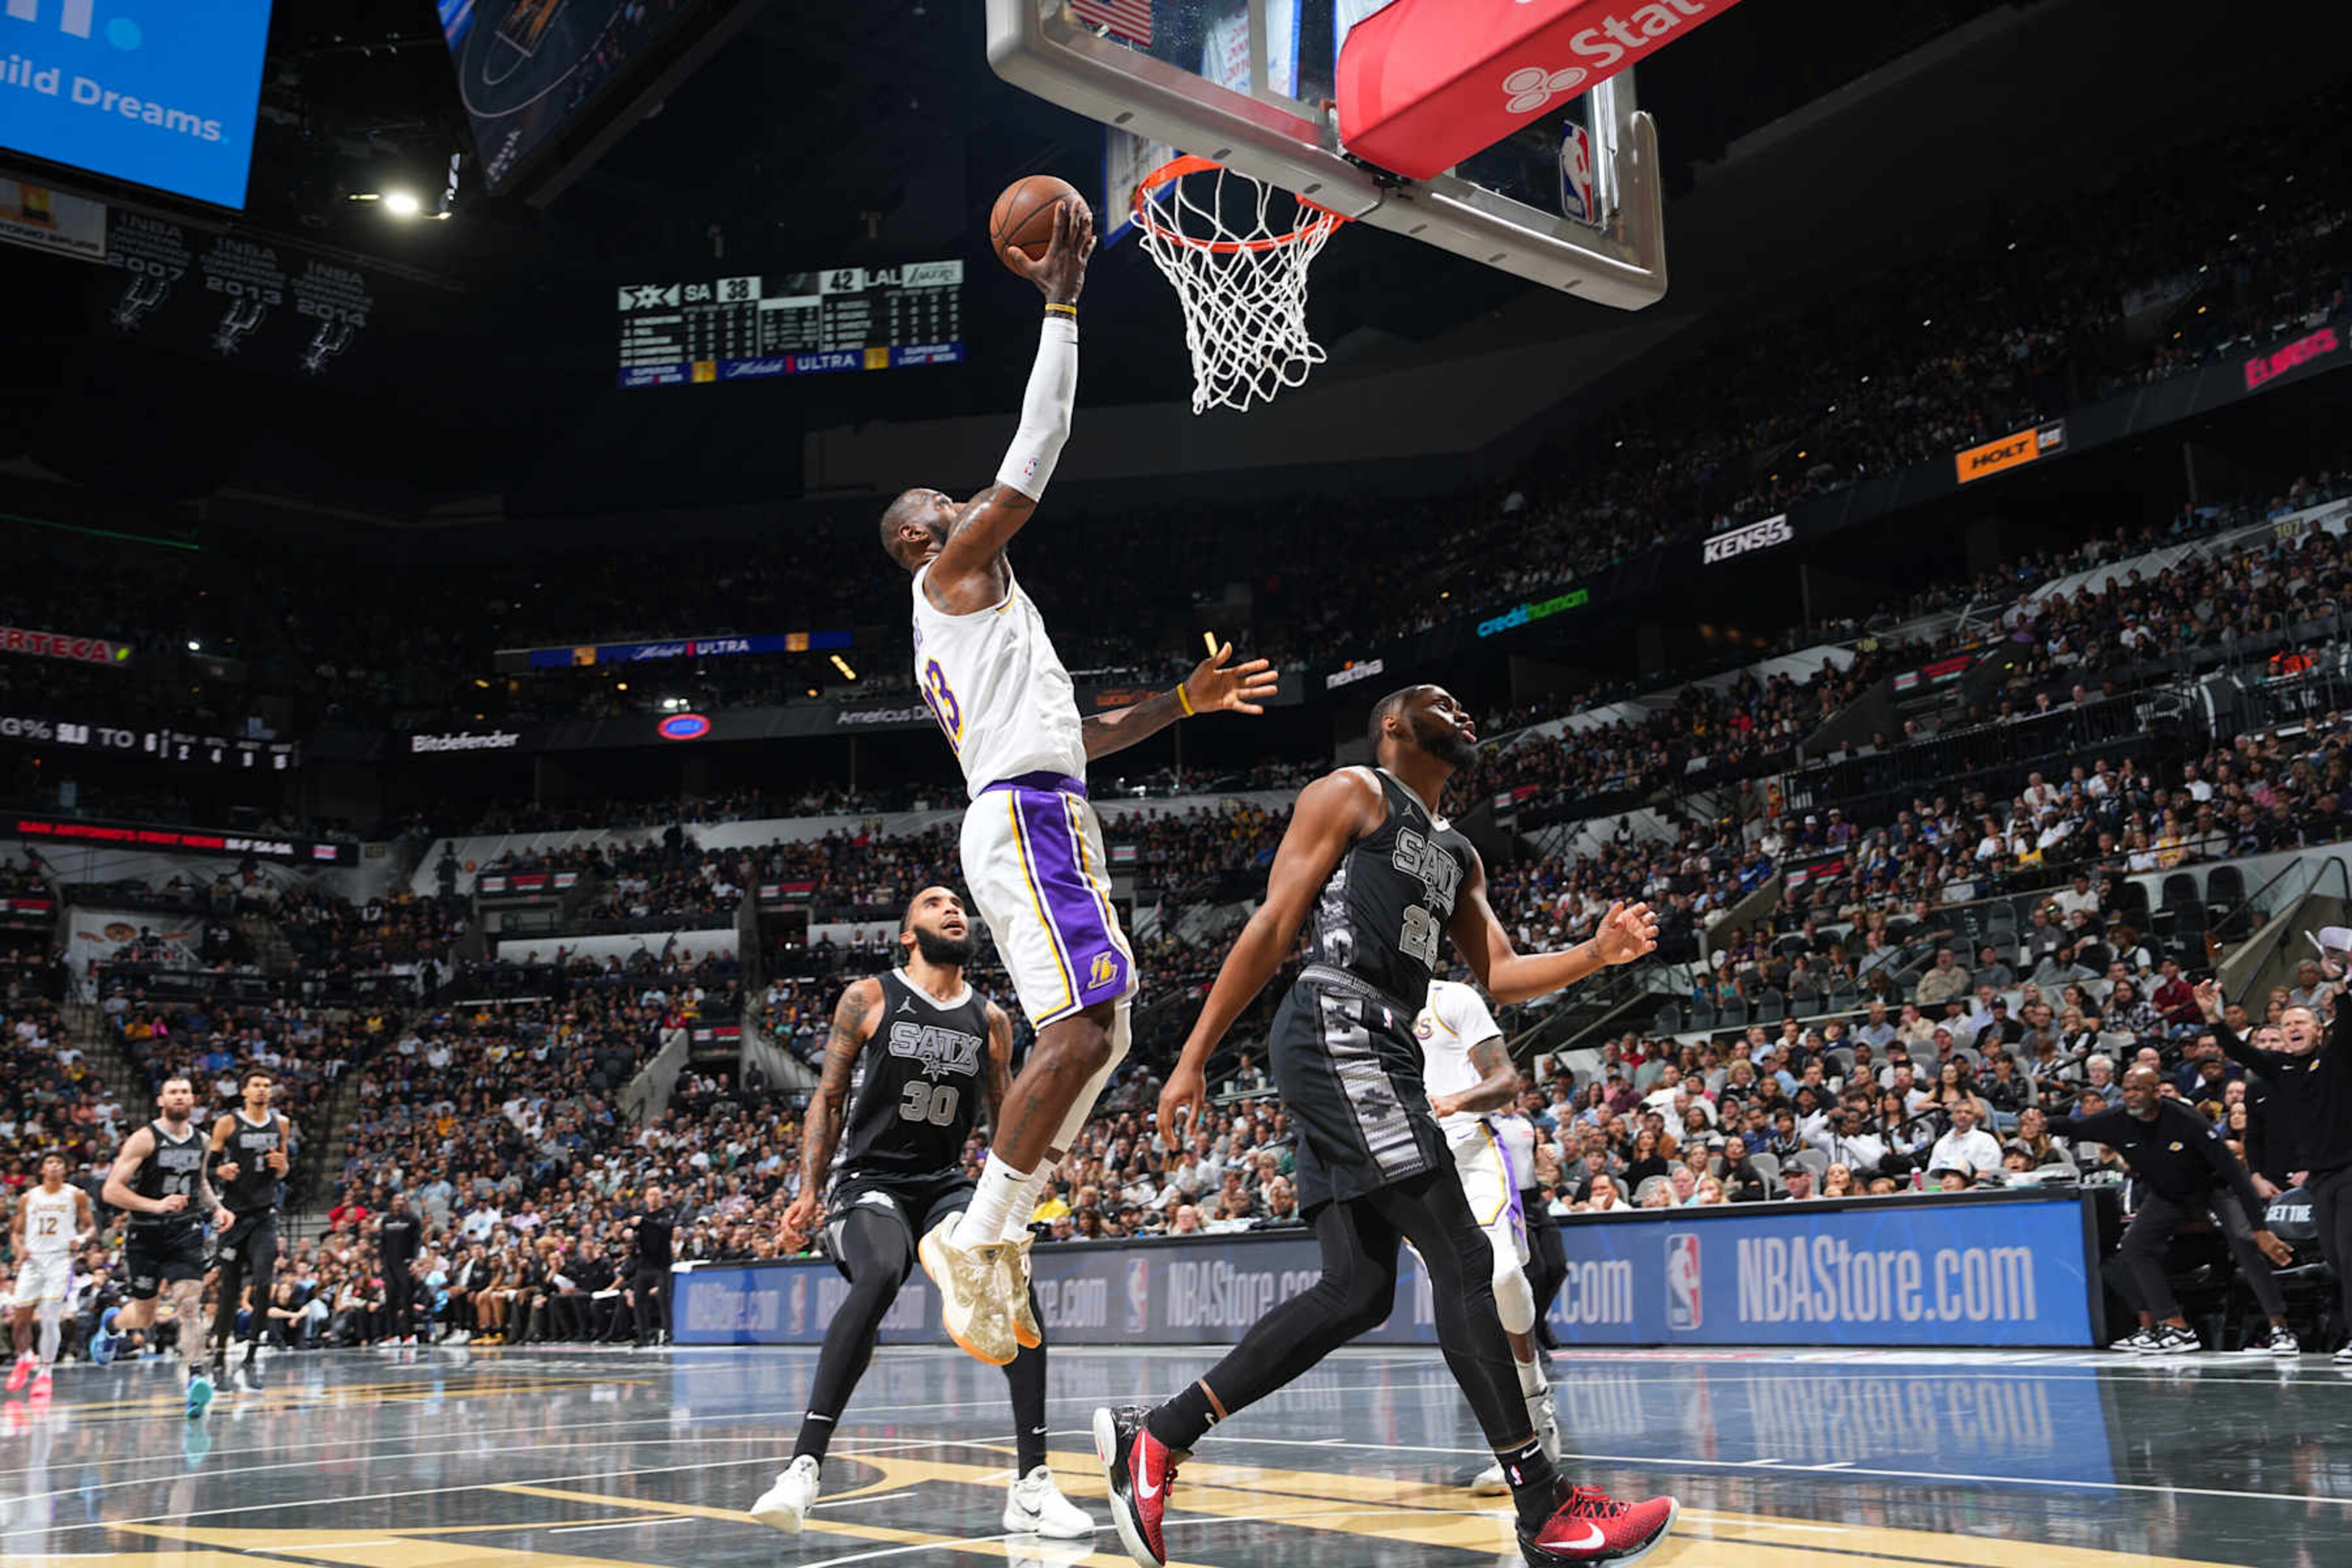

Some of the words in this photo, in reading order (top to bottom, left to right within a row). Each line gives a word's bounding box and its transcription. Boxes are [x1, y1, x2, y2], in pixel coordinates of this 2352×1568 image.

[72, 76, 230, 145] Dreams.
[107, 252, 187, 282] 2007
[829, 271, 854, 291] 42
[863, 269, 902, 288] LAL
[206, 277, 283, 306] 2013
[685, 283, 711, 302] SA
[727, 280, 749, 299] 38
[297, 298, 366, 328] 2014
[796, 354, 856, 371] ULTRA
[1970, 438, 2030, 470] HOLT
[2274, 519, 2302, 538] 107
[696, 639, 751, 655] ULTRA
[836, 707, 911, 725] Americus
[0, 717, 53, 739] G%
[96, 727, 135, 748] TO
[411, 729, 521, 753] Bitdefender
[1393, 826, 1464, 916] SATX
[888, 1020, 983, 1077] SATX
[899, 1080, 960, 1127] 30
[39, 1217, 57, 1236] 12
[1736, 1234, 2037, 1323] NBAStore.com
